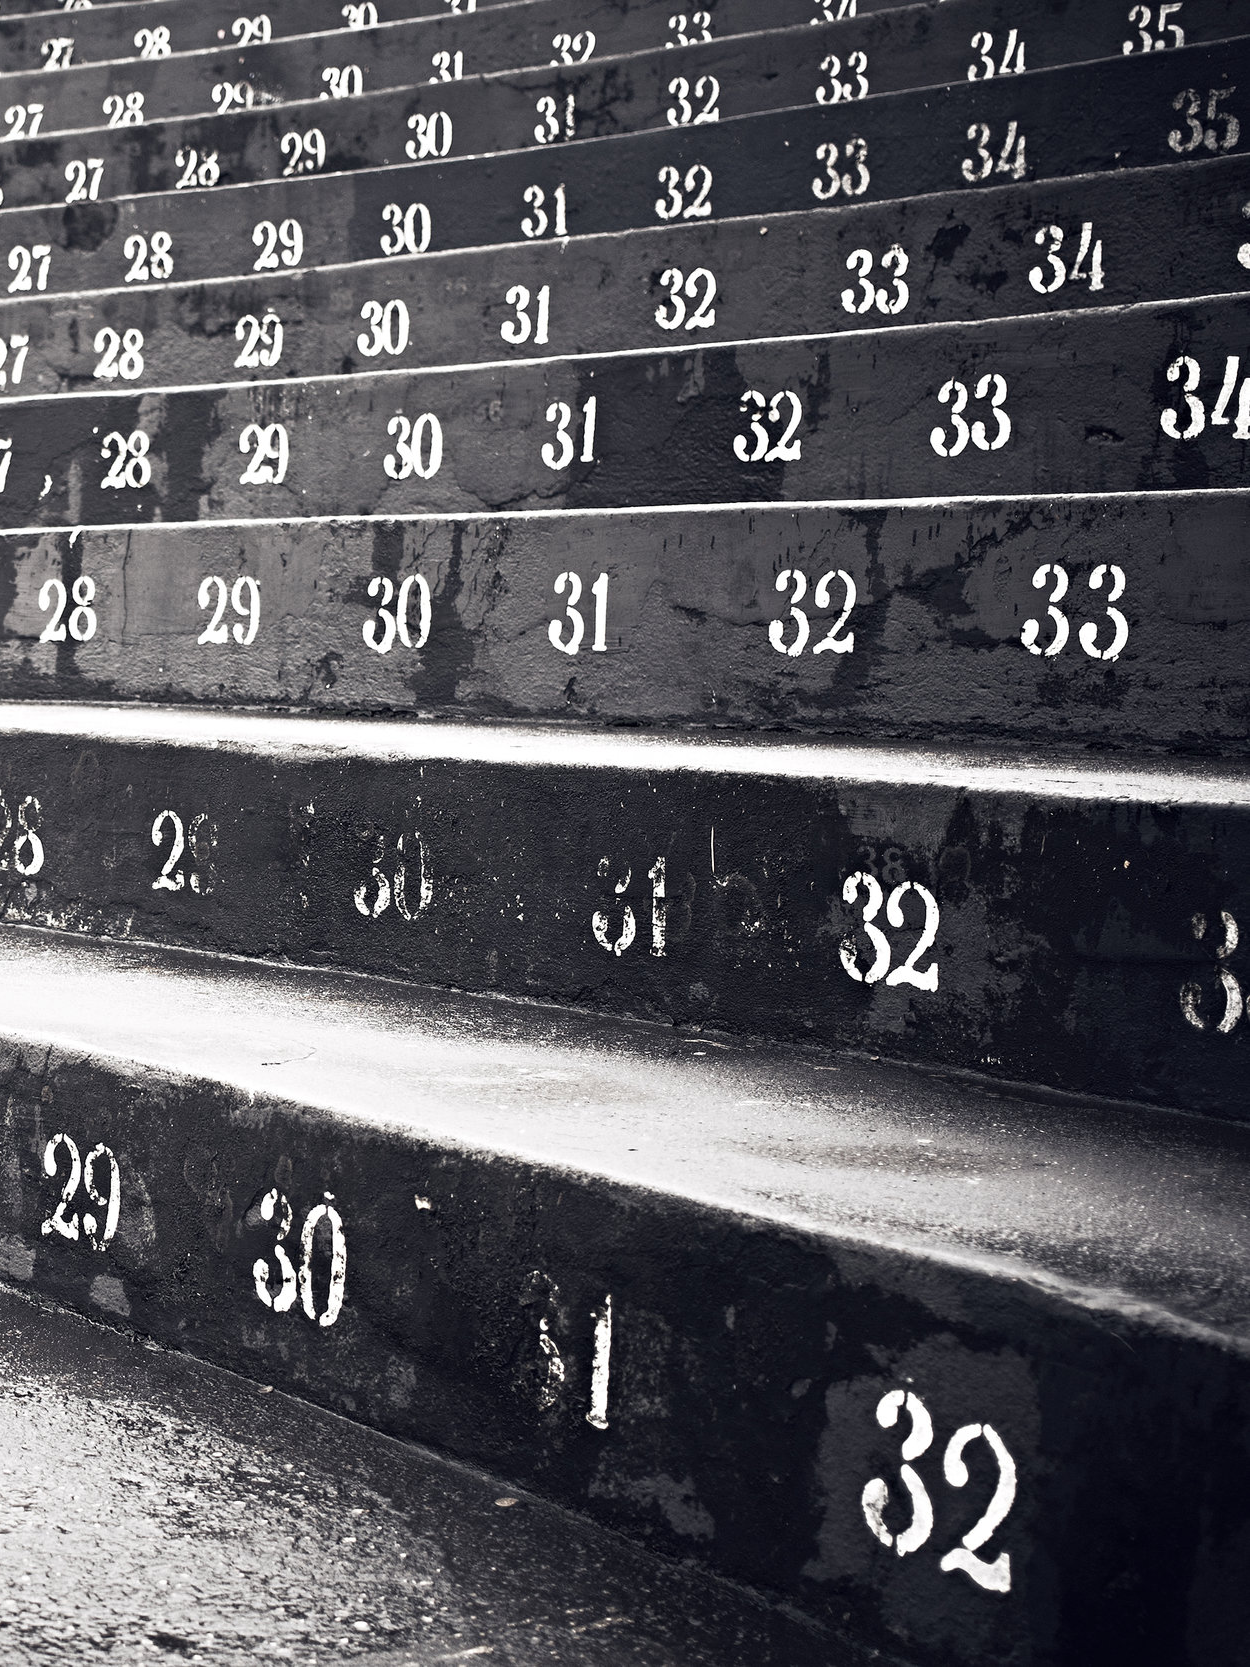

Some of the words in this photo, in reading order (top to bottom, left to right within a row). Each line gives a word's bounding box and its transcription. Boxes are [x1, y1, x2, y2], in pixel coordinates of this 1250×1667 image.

[4, 104, 44, 139] 27
[103, 91, 144, 127] 28
[429, 51, 464, 84] 31
[64, 158, 104, 203] 27
[281, 128, 326, 175] 29
[405, 112, 452, 158] 30
[667, 76, 719, 129] 32
[816, 52, 869, 104] 33
[968, 28, 1026, 81] 34
[1123, 3, 1187, 55] 35
[134, 26, 171, 59] 28
[232, 15, 271, 47] 29
[8, 245, 51, 293] 27
[124, 231, 173, 282] 28
[252, 219, 303, 271] 29
[380, 203, 431, 255] 30
[521, 183, 567, 237] 31
[655, 165, 712, 220] 32
[812, 138, 870, 200] 33
[962, 122, 1025, 181] 34
[1168, 87, 1239, 153] 35
[93, 327, 144, 382] 28
[234, 308, 283, 368] 29
[357, 299, 412, 356] 30
[501, 285, 549, 344] 31
[655, 268, 716, 330] 32
[841, 244, 909, 314] 33
[1029, 222, 1104, 293] 34
[101, 429, 154, 489] 28
[239, 423, 289, 484] 29
[384, 413, 443, 479] 30
[541, 396, 600, 470] 31
[733, 390, 802, 462] 32
[930, 374, 1011, 457] 33
[1160, 356, 1250, 439] 34
[38, 575, 97, 643] 28
[198, 574, 260, 645] 29
[362, 573, 431, 656] 30
[548, 572, 608, 655] 31
[769, 569, 856, 657] 32
[1021, 564, 1128, 662] 33
[839, 871, 939, 992] 32
[41, 1133, 123, 1251] 29
[253, 1188, 347, 1327] 30
[862, 1390, 1017, 1593] 32
